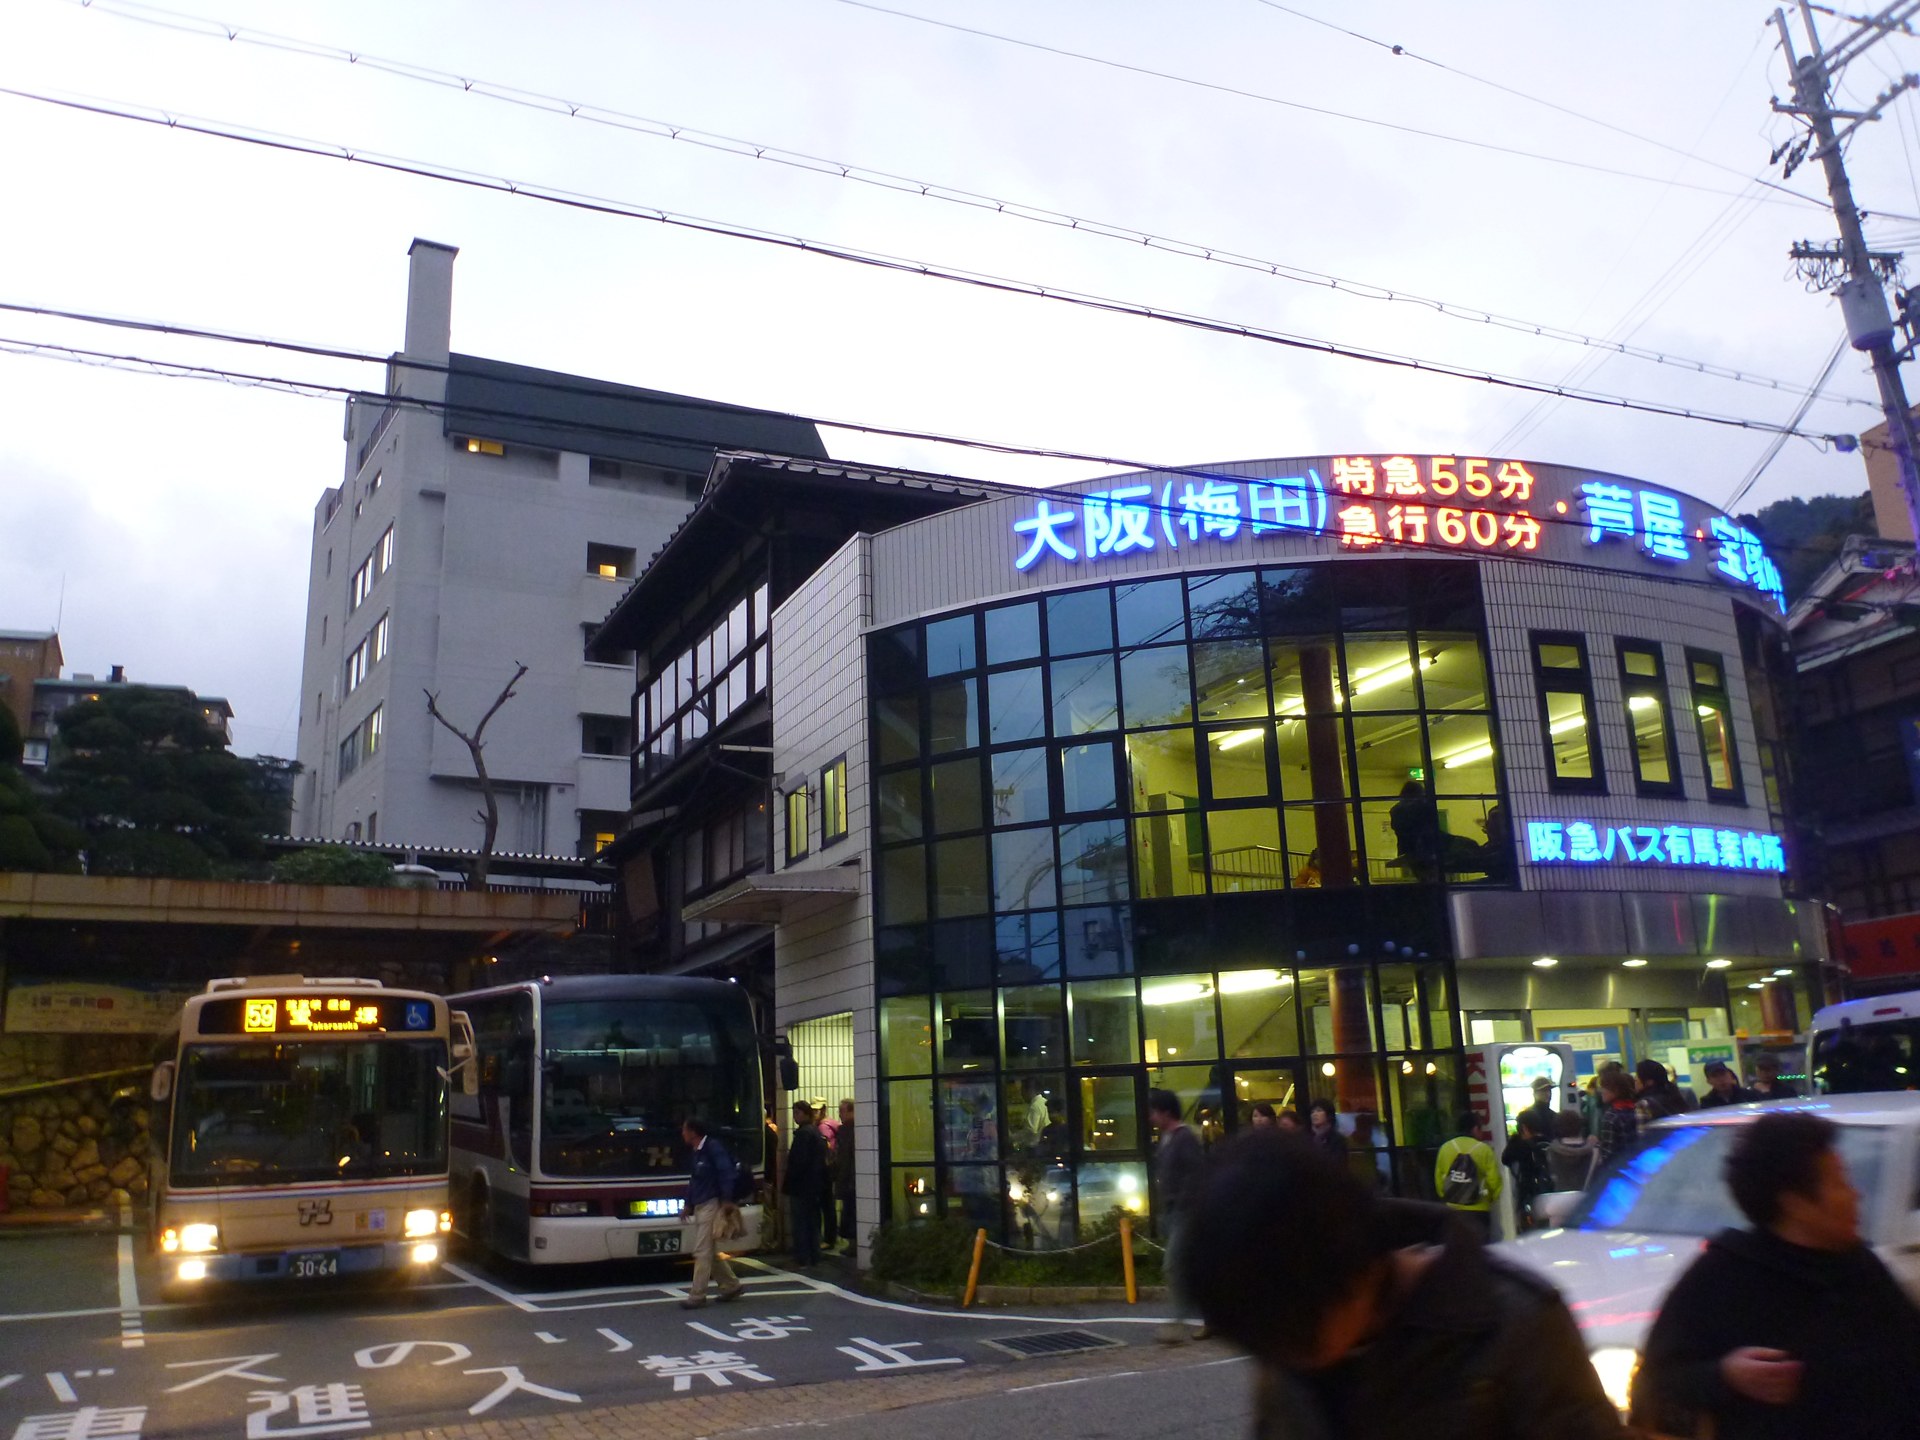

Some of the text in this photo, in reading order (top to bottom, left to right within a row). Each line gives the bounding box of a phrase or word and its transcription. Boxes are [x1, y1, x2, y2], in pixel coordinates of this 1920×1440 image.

[1332, 456, 1535, 501] 特急55分
[1014, 468, 1328, 572] 大阪(梅田)
[1338, 505, 1542, 552] 急行60分
[1527, 821, 1787, 873] 阪急バス有馬案内所
[248, 1003, 274, 1028] 59
[1466, 1052, 1492, 1141] KIRI
